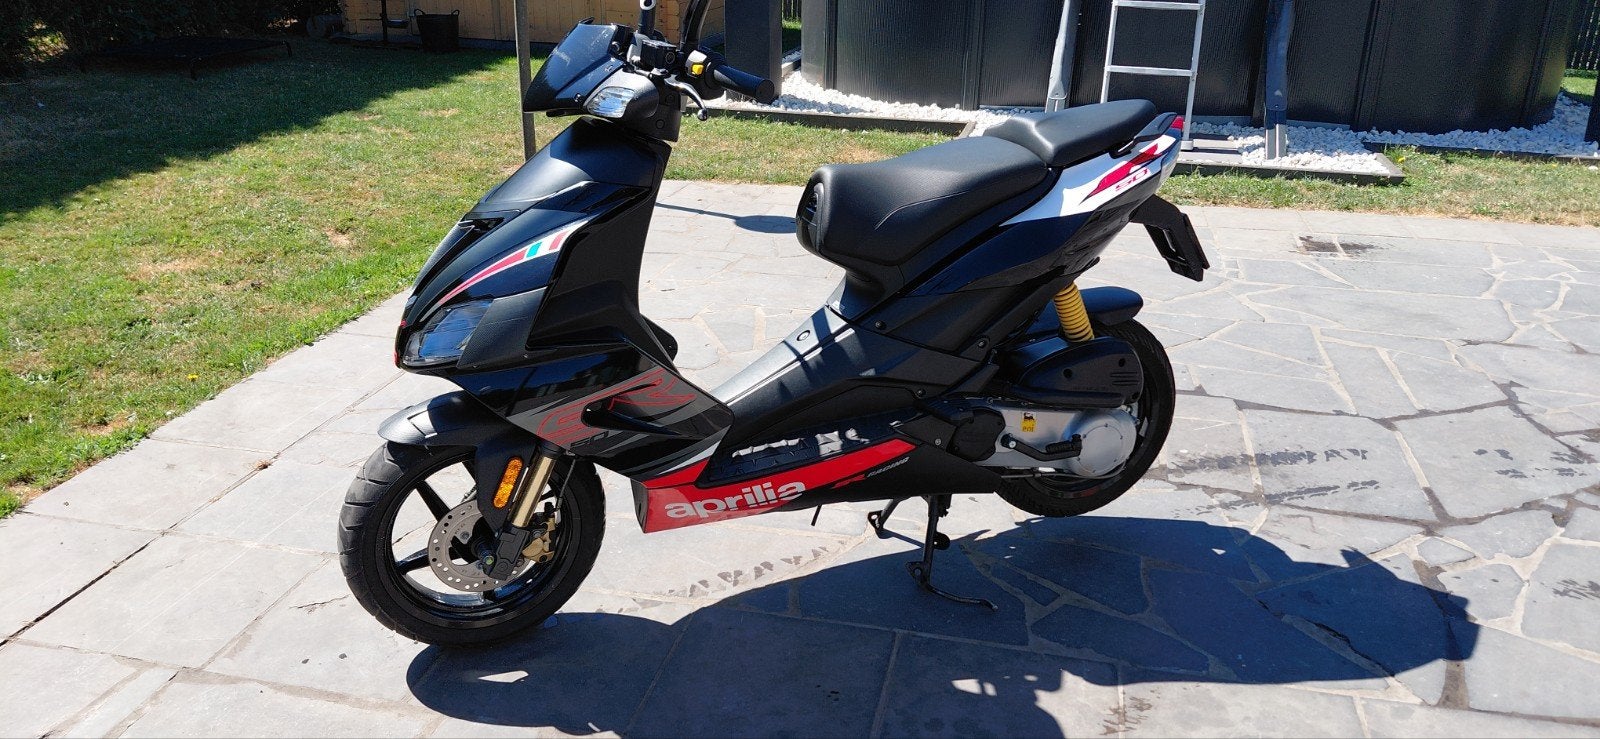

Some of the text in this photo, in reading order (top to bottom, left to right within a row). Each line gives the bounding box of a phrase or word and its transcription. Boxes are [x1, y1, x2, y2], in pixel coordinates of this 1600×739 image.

[1115, 168, 1148, 192] 50
[866, 456, 910, 478] RACING
[664, 481, 806, 519] aprilia
